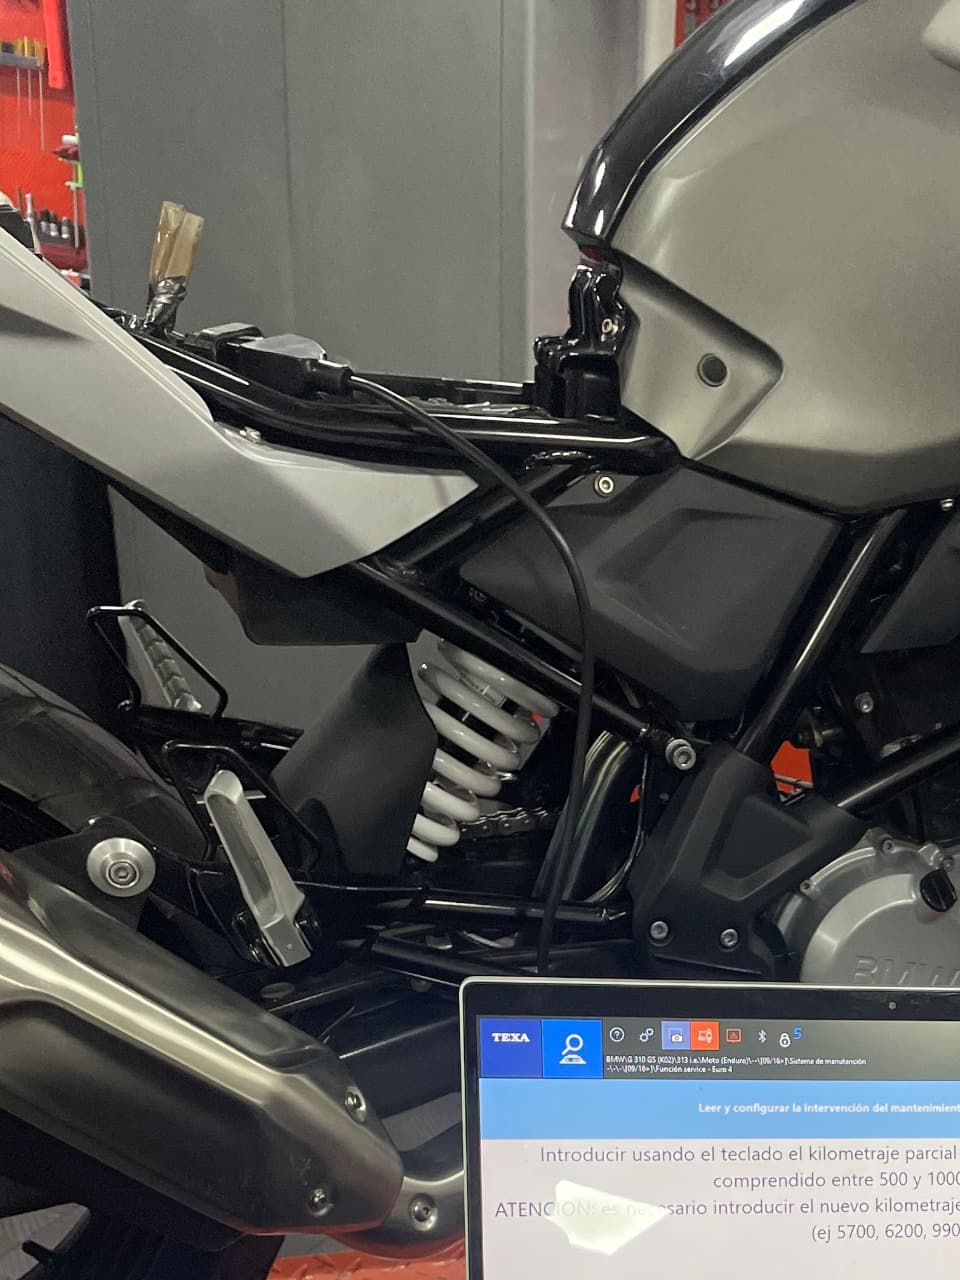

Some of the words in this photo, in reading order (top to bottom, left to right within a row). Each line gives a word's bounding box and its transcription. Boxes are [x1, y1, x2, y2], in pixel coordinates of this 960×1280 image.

[491, 1032, 531, 1043] TEXA
[647, 1056, 656, 1064] GS
[699, 1103, 721, 1113] Leer
[724, 1105, 730, 1115] y
[733, 1103, 790, 1115] configurar
[792, 1103, 801, 1113] la
[804, 1103, 870, 1113] intervención
[872, 1103, 888, 1113] del
[539, 1146, 627, 1162] Introducir
[632, 1146, 695, 1162] usando
[700, 1146, 715, 1162] el
[721, 1146, 783, 1162] teclado
[788, 1146, 803, 1162] el
[808, 1145, 900, 1165] kilometraje
[905, 1144, 957, 1164] parcial
[712, 1172, 826, 1192] comprendido
[831, 1174, 874, 1188] entre
[879, 1172, 908, 1187] 500
[913, 1175, 922, 1190] y
[712, 1199, 795, 1216] introducir
[800, 1199, 814, 1215] el
[820, 1204, 870, 1214] nuevo
[811, 1224, 831, 1242] (ej
[836, 1224, 880, 1241] 5700,
[885, 1223, 926, 1241] 6200,
